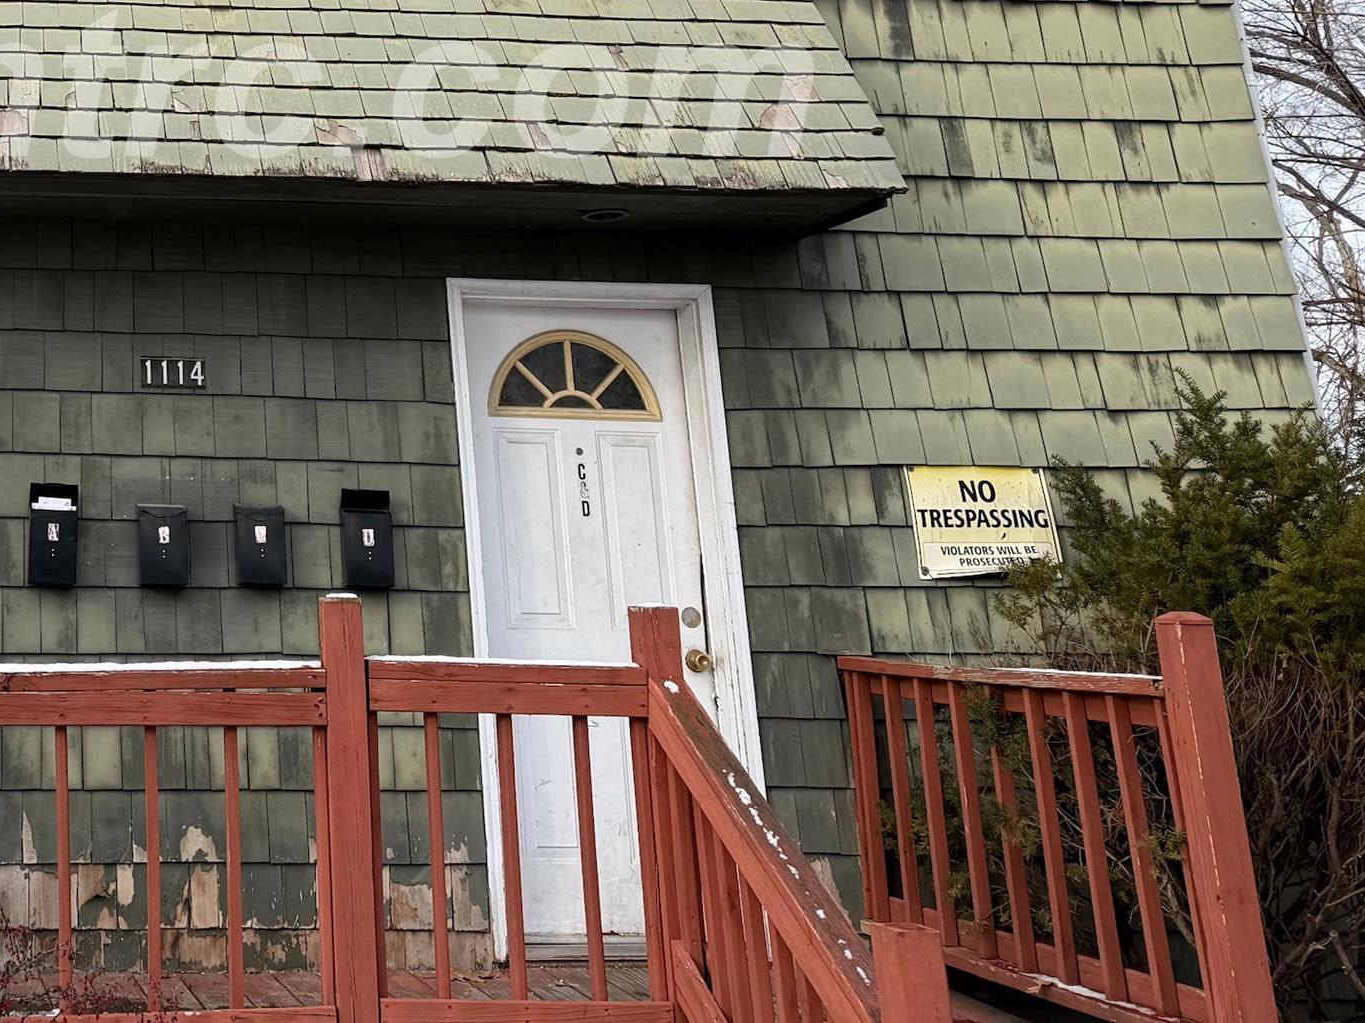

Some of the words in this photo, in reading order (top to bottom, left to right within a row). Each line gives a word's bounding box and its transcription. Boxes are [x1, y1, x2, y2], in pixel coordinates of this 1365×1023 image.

[144, 359, 205, 386] 1114
[958, 479, 997, 503] NO
[916, 508, 1051, 529] TRESPASSING
[940, 545, 995, 556] VIOLATORS
[996, 545, 1022, 555] WILL
[1024, 545, 1038, 554] BE
